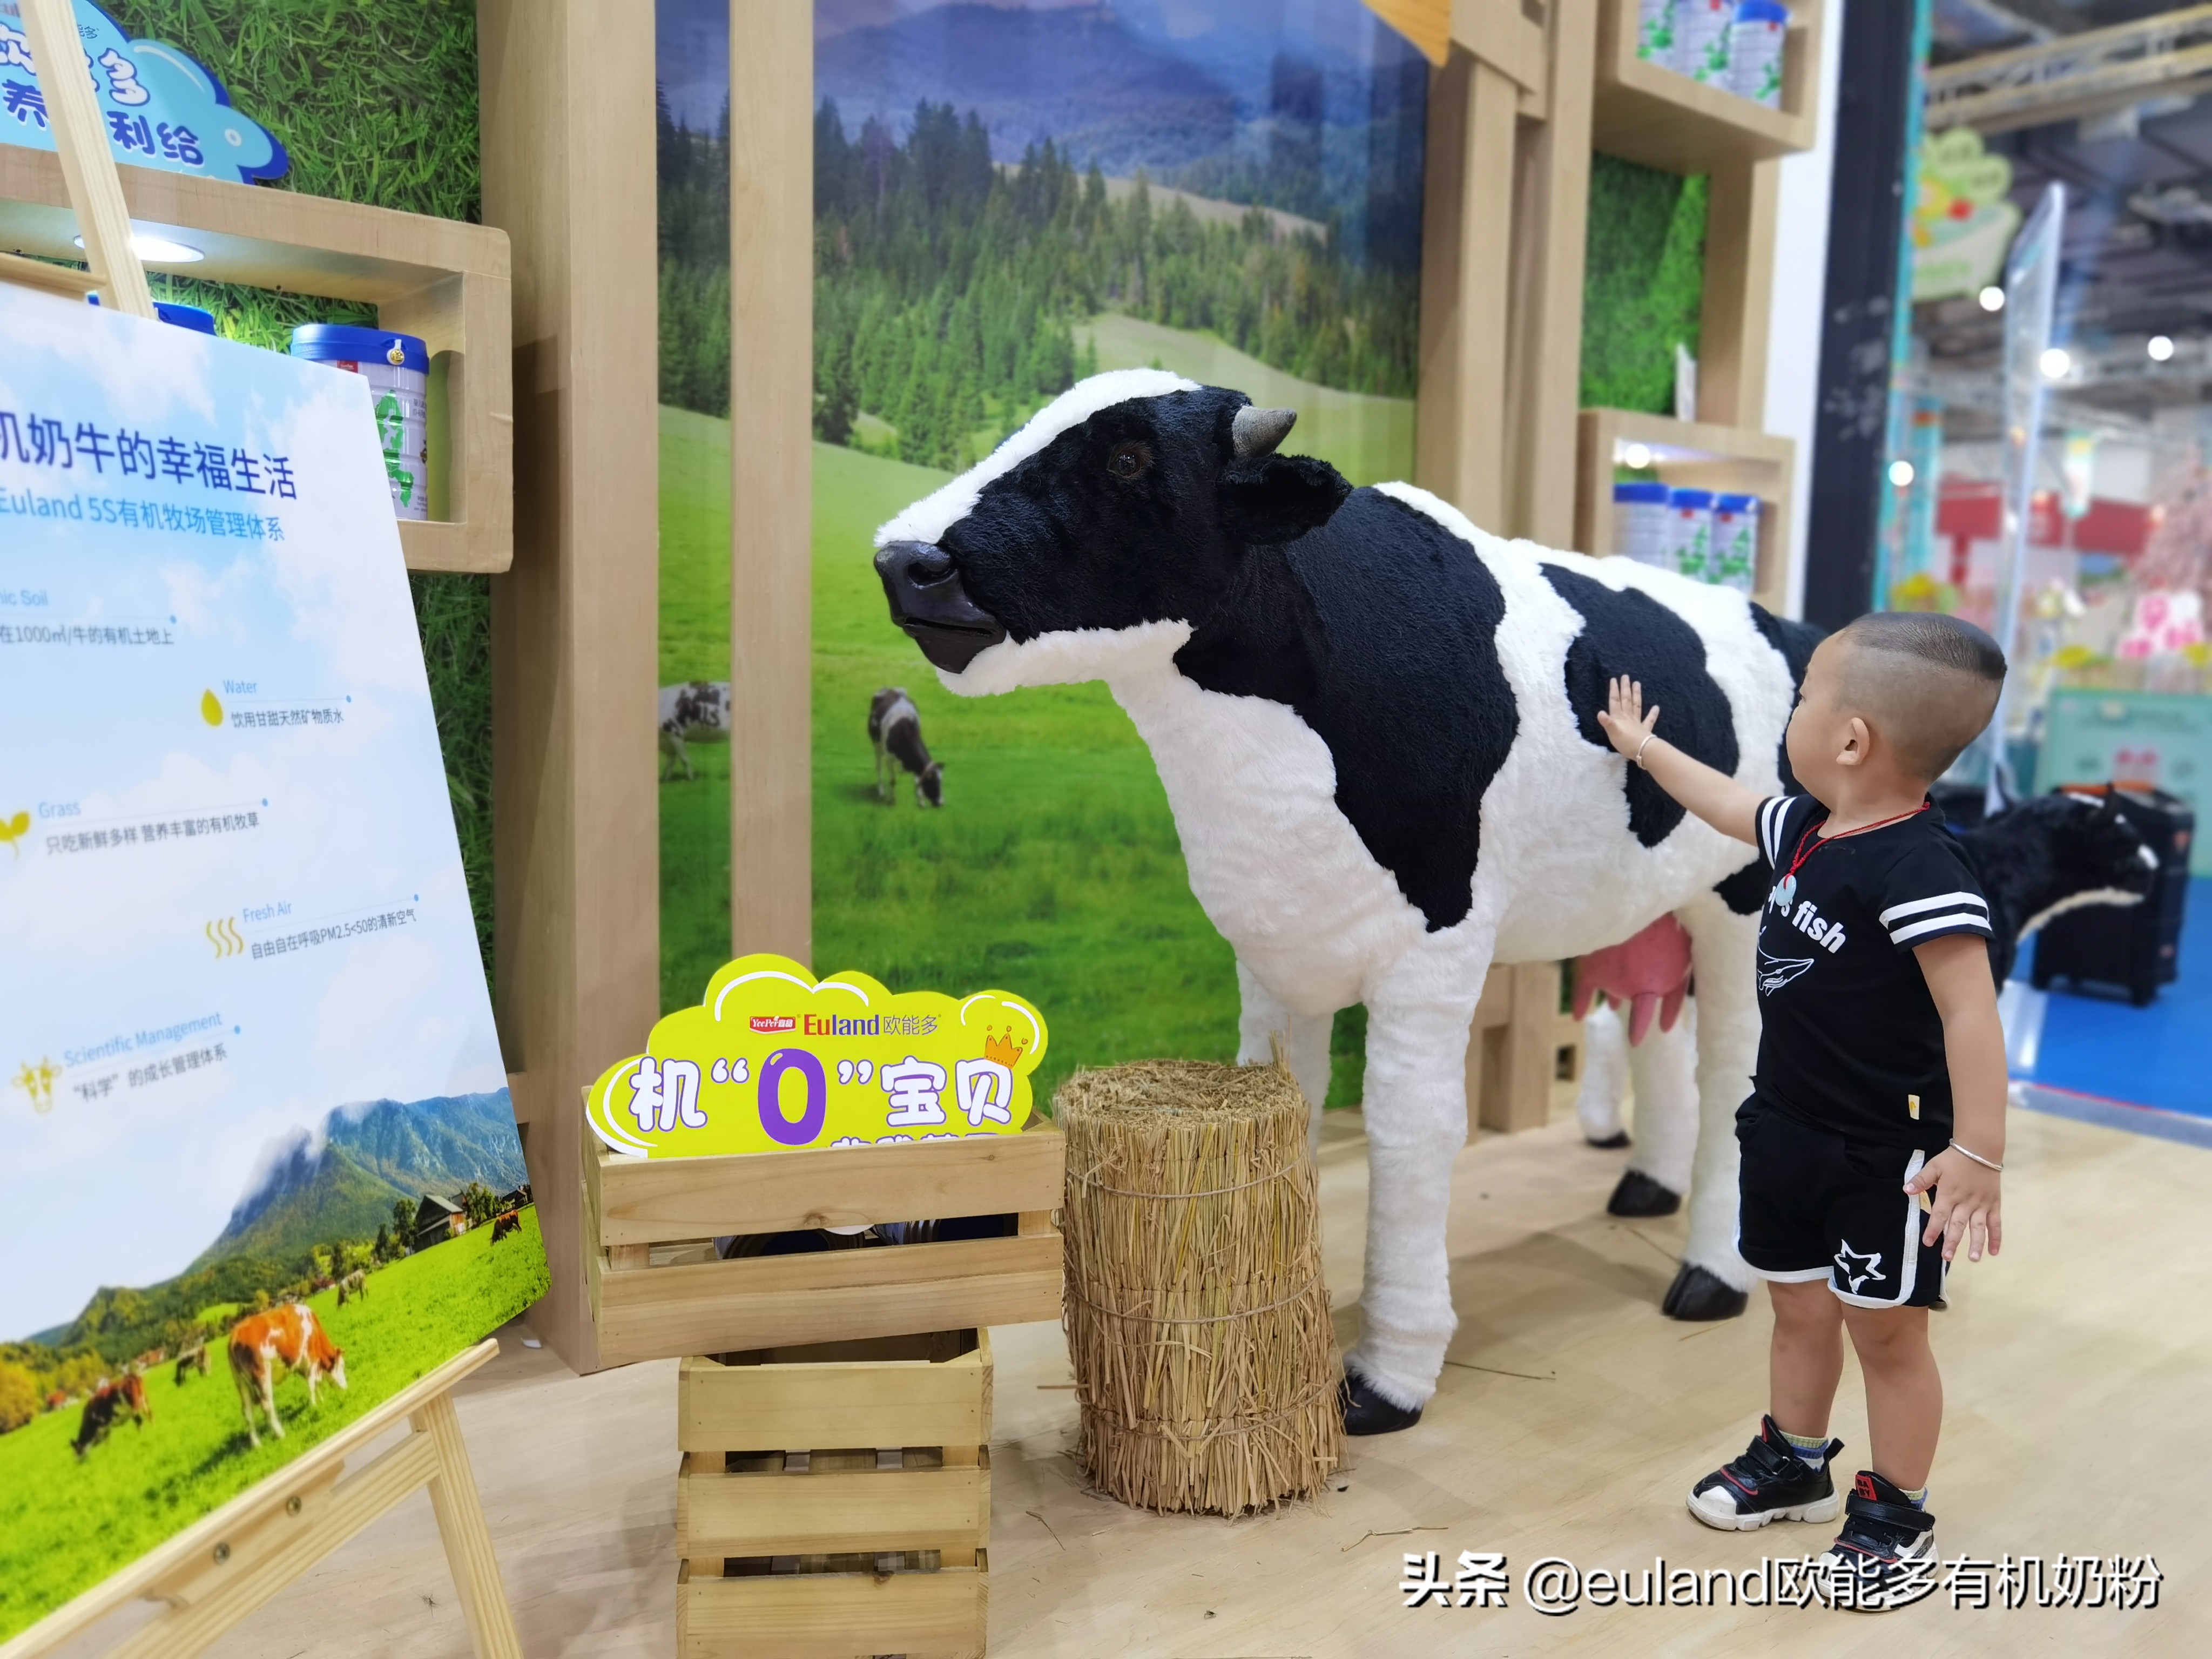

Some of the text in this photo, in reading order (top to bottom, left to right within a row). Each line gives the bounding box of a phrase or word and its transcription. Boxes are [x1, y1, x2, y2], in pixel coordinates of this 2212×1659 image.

[21, 589, 49, 606] Soil
[222, 679, 257, 694] Water
[231, 708, 344, 728] 饮用甘甜天然矿物质水
[38, 802, 81, 819] Grass
[242, 902, 292, 922] Fresh Air
[1792, 900, 1846, 954] fish
[64, 1011, 222, 1067] Scientific Management
